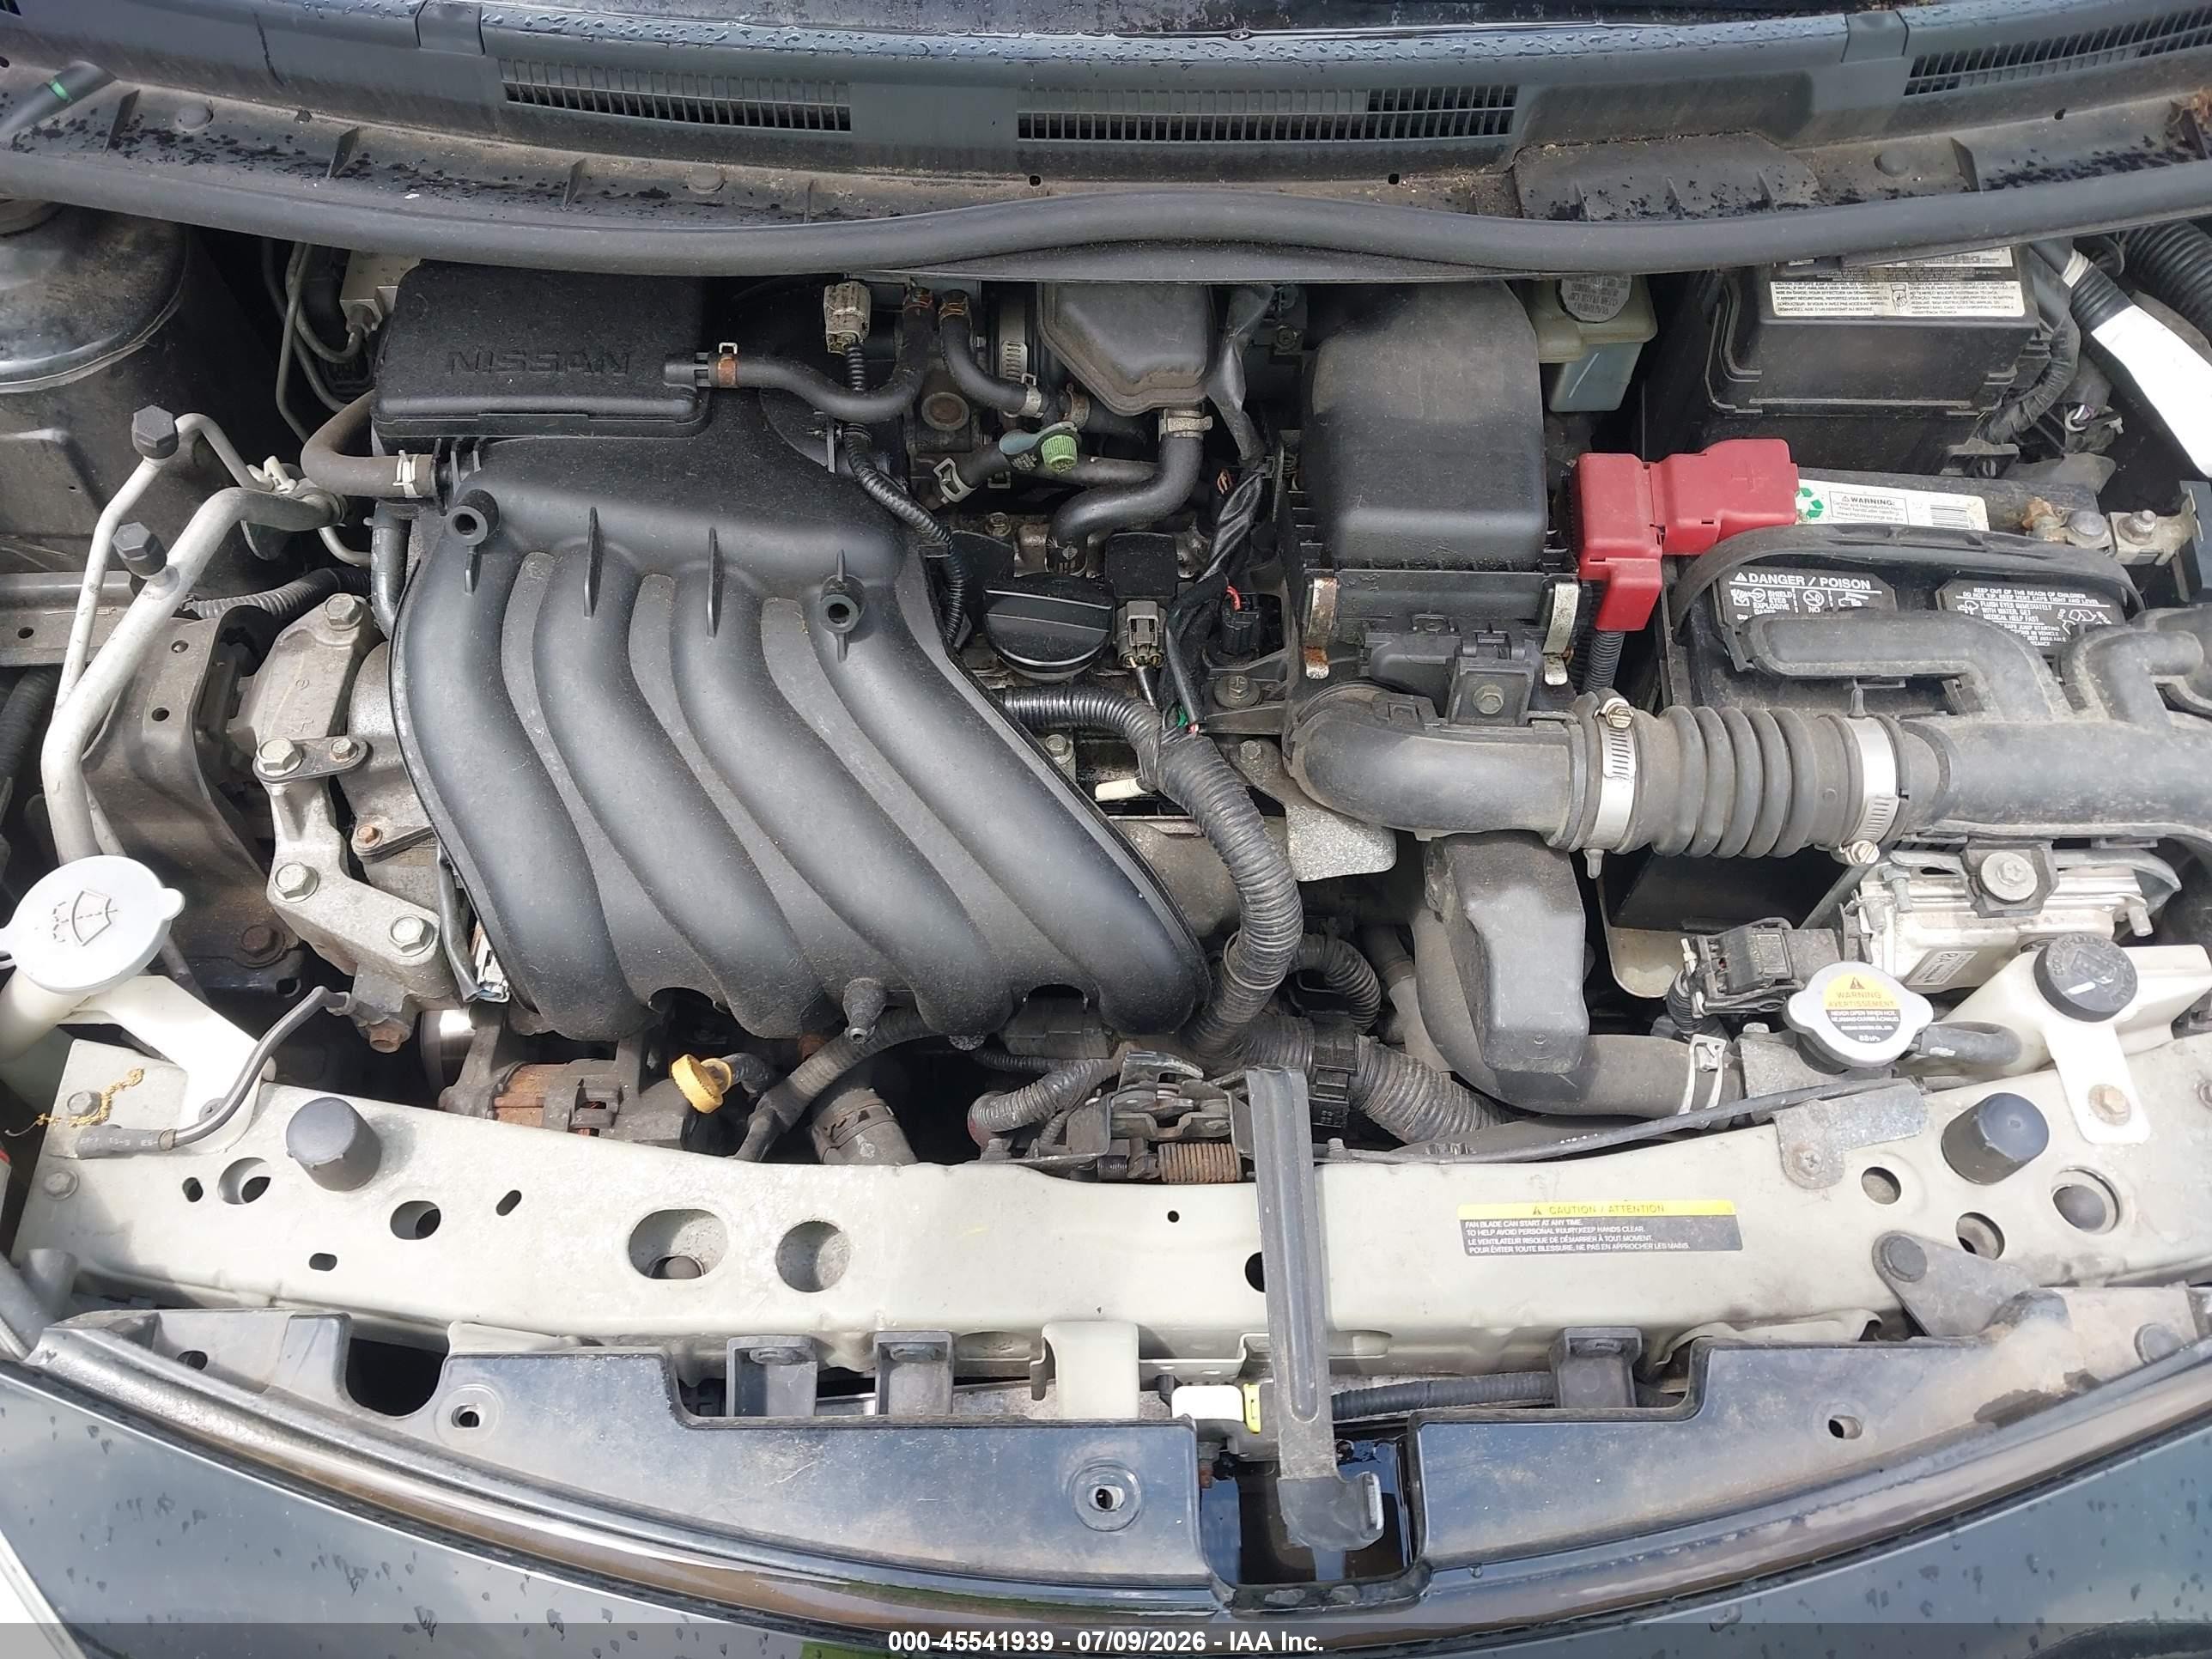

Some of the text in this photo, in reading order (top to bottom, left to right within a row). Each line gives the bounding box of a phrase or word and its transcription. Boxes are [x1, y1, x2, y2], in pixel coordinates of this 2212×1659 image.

[444, 349, 631, 376] NISSAN
[1850, 496, 1895, 506] WARNING:
[1748, 573, 1871, 590] DANGER / POISON
[1753, 602, 1790, 611] EXPLOSIVE
[1549, 1206, 1596, 1214] CAUTION
[1608, 1204, 1664, 1212] ATTENTION
